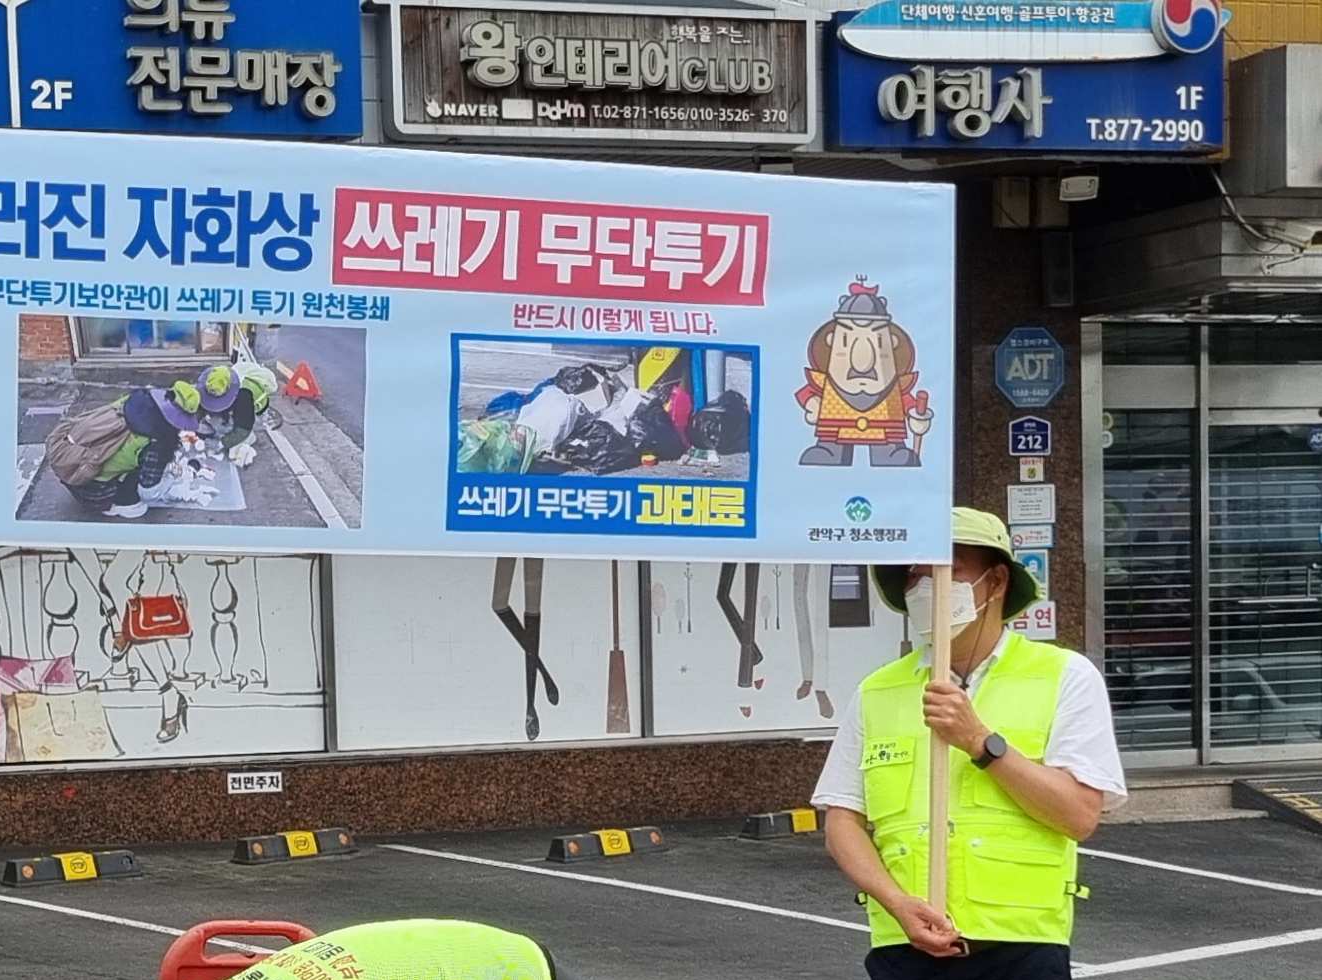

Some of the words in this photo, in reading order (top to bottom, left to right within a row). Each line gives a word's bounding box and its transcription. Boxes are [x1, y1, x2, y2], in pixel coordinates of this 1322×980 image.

[30, 80, 74, 110] 2F
[126, 46, 342, 119] 전문매장
[444, 104, 499, 118] NAVER
[879, 65, 1053, 140] 여행사
[1176, 86, 1205, 111] 1F
[1086, 117, 1205, 143] T.877-2990
[123, 186, 320, 272] 자화상
[342, 201, 520, 281] 쓰레기
[537, 214, 758, 294] 무단투기
[176, 286, 243, 315] 쓰레기
[251, 290, 294, 317] 투기
[301, 291, 390, 321] 원천봉쇄
[513, 304, 575, 331] 반드시
[582, 306, 643, 333] 이렇게
[650, 310, 717, 335] 됩니다.
[1006, 353, 1054, 381] ADT
[1017, 435, 1042, 449] 212
[457, 486, 531, 517] 쓰레기
[537, 488, 631, 520] 무단투기
[636, 483, 745, 526] 과태료
[808, 528, 846, 541] 관악구
[849, 528, 907, 542] 청소행정과
[228, 773, 281, 792] 전면주차
